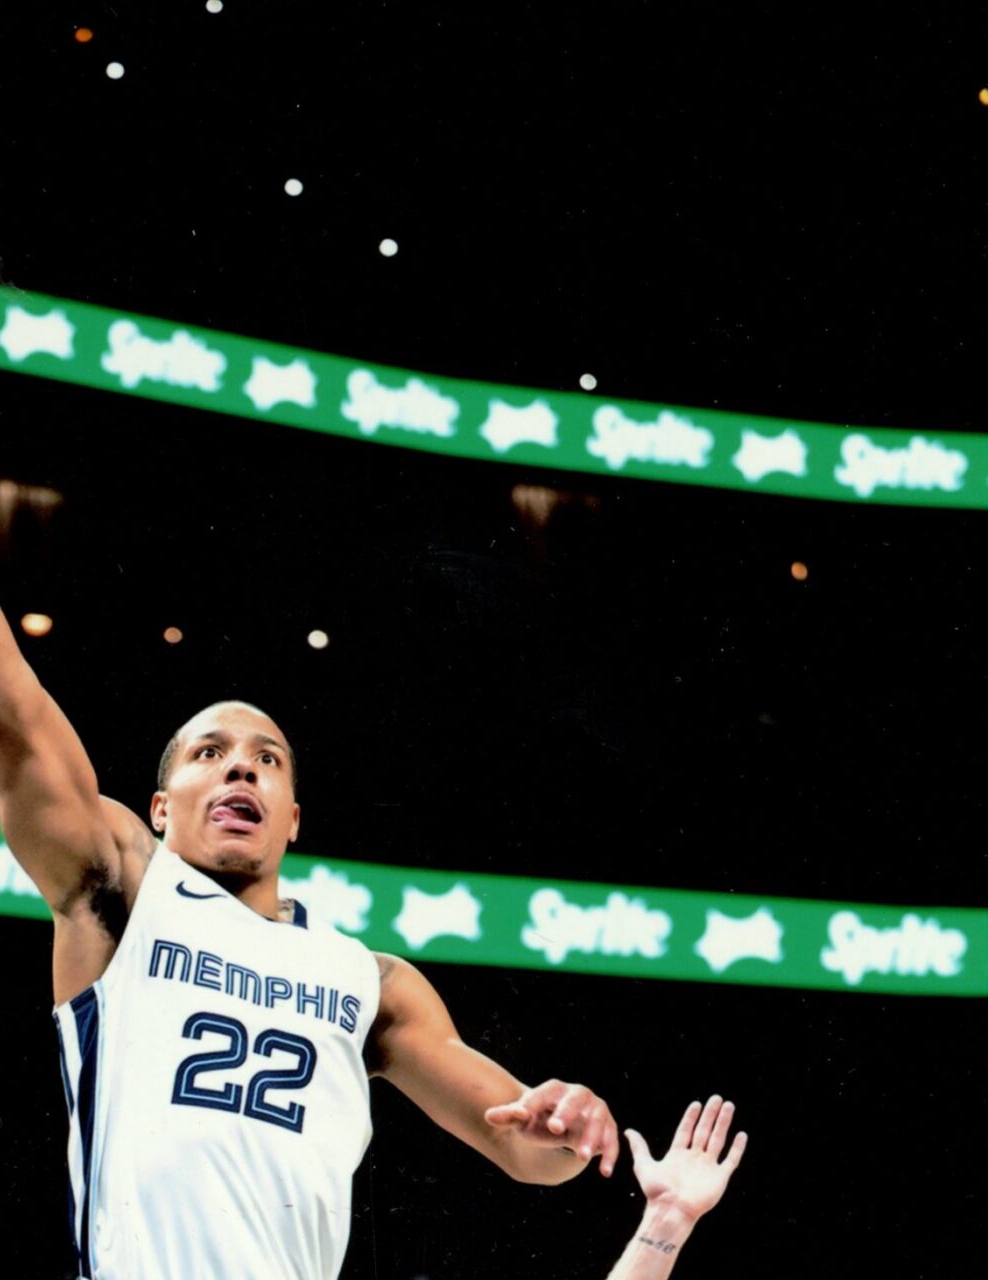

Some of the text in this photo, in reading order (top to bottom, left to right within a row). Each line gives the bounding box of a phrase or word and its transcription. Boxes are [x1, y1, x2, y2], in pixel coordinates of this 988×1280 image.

[102, 319, 226, 391] Sprite
[341, 369, 459, 437] Sprite
[586, 405, 713, 468] Sprite
[835, 434, 967, 496] Sprite
[521, 887, 672, 964] Sprite
[820, 911, 967, 984] Sprite
[148, 939, 361, 1034] MEMPHIS
[171, 1011, 317, 1134] 22
